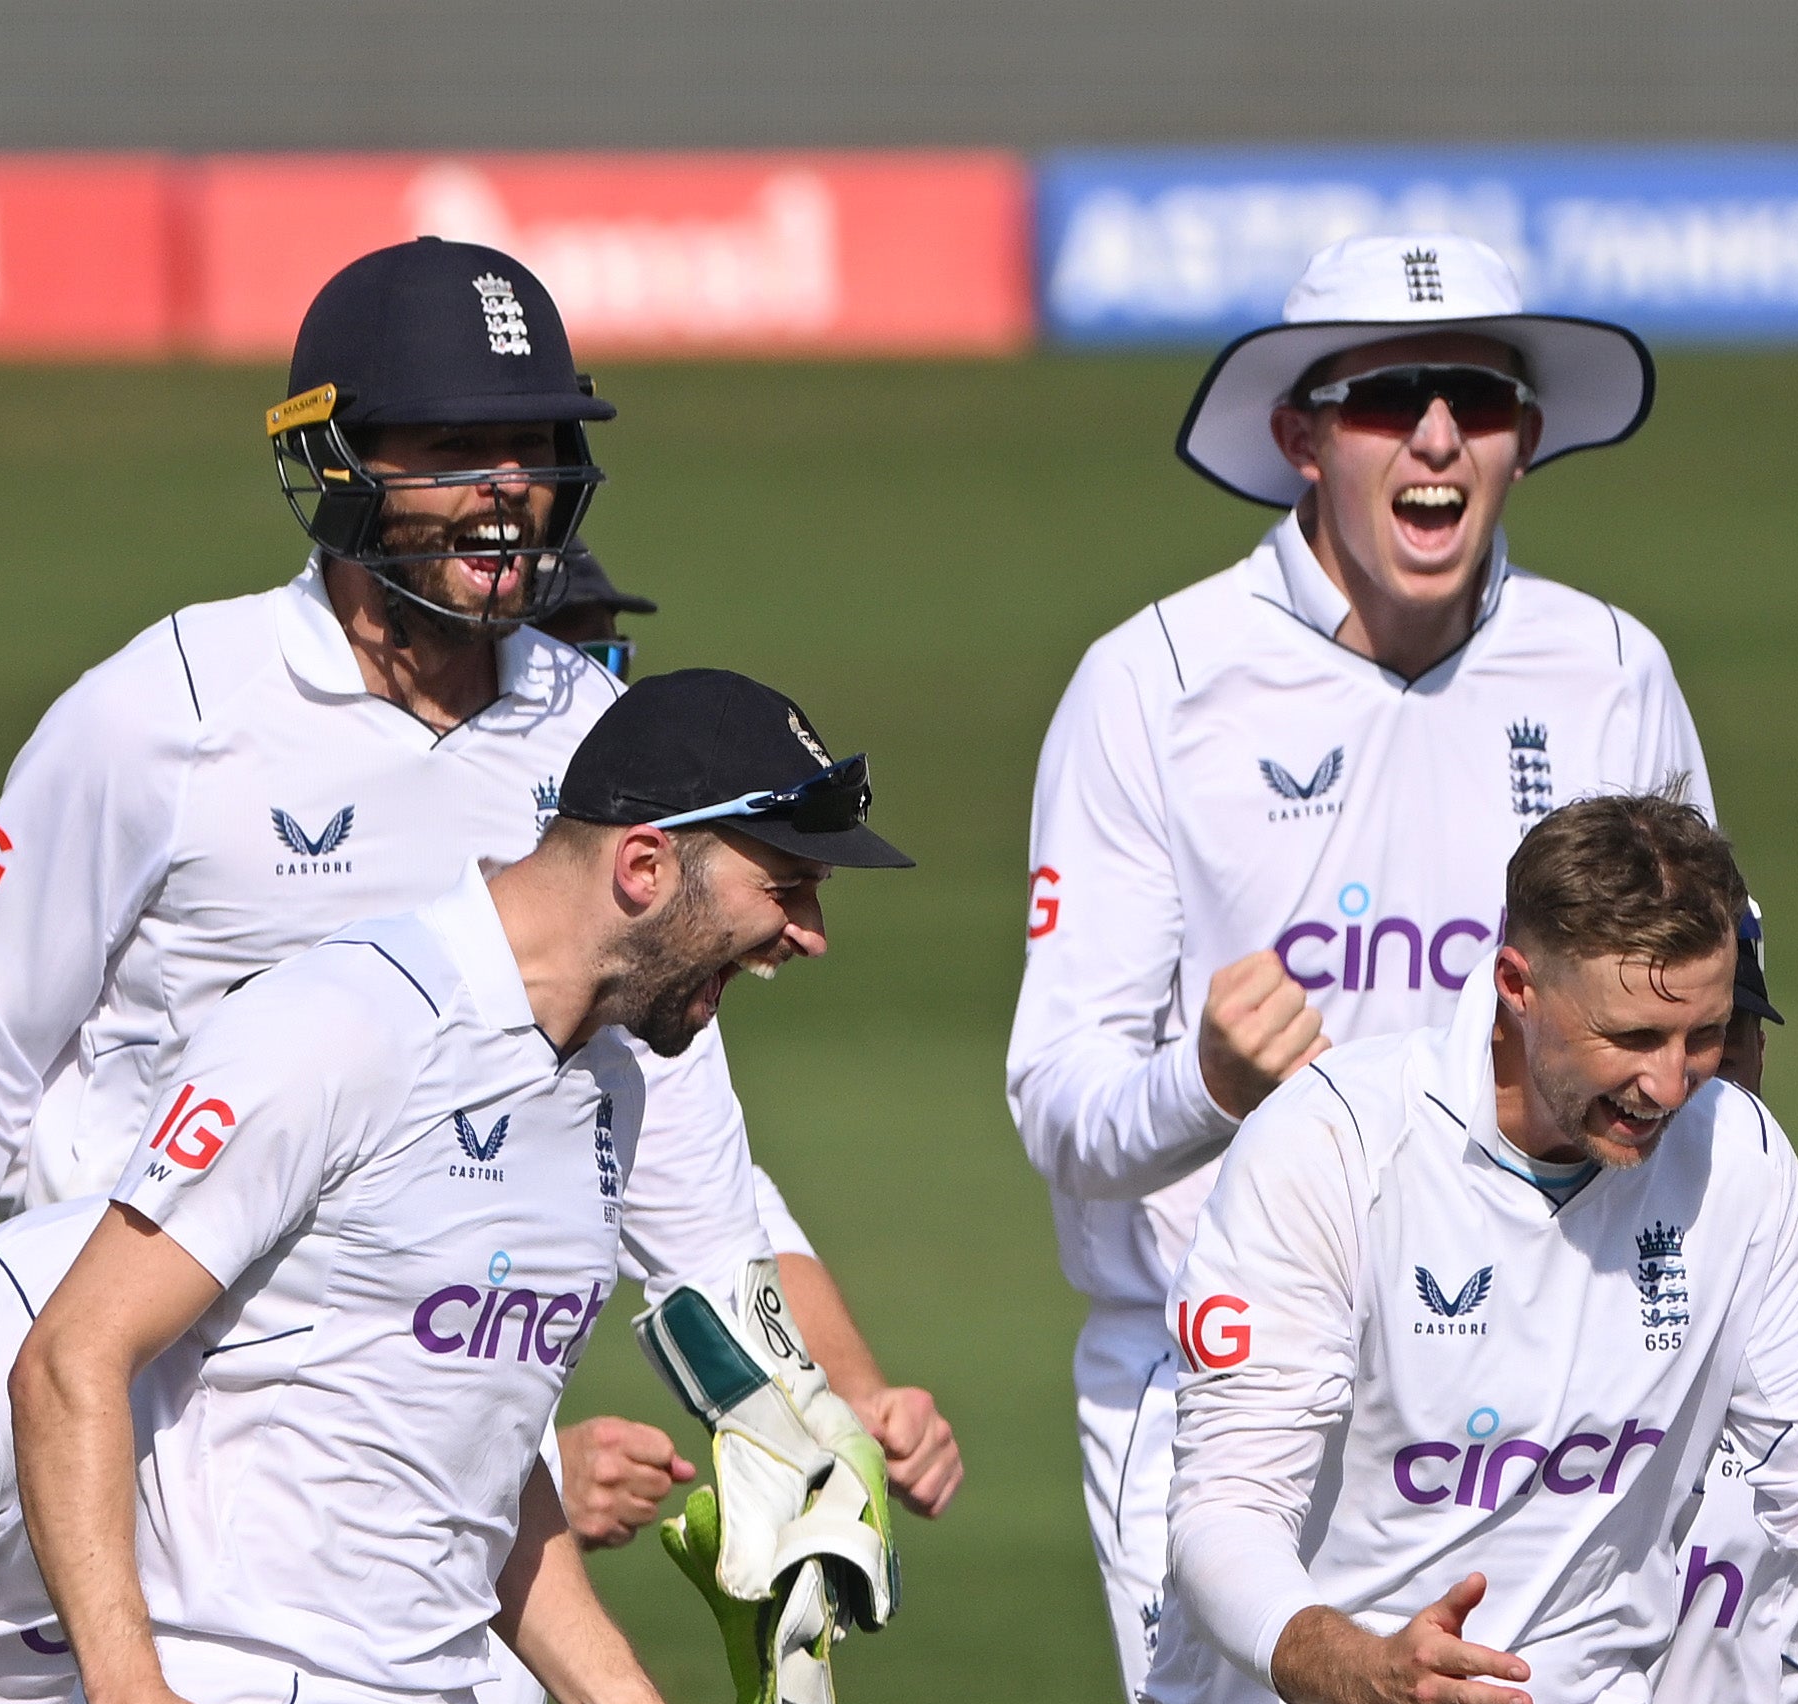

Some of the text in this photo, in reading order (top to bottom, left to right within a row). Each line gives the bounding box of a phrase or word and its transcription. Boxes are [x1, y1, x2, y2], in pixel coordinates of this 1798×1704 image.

[275, 861, 353, 876] CASTORE
[1029, 865, 1060, 940] G
[1274, 882, 1507, 991] cinc
[149, 1083, 236, 1170] IG
[449, 1165, 505, 1182] CASTORE
[1178, 1294, 1251, 1373] IG
[1414, 1322, 1488, 1335] CASTORE
[1644, 1332, 1682, 1352] 655
[1393, 1406, 1666, 1512] cinch
[1721, 1460, 1744, 1478] 67
